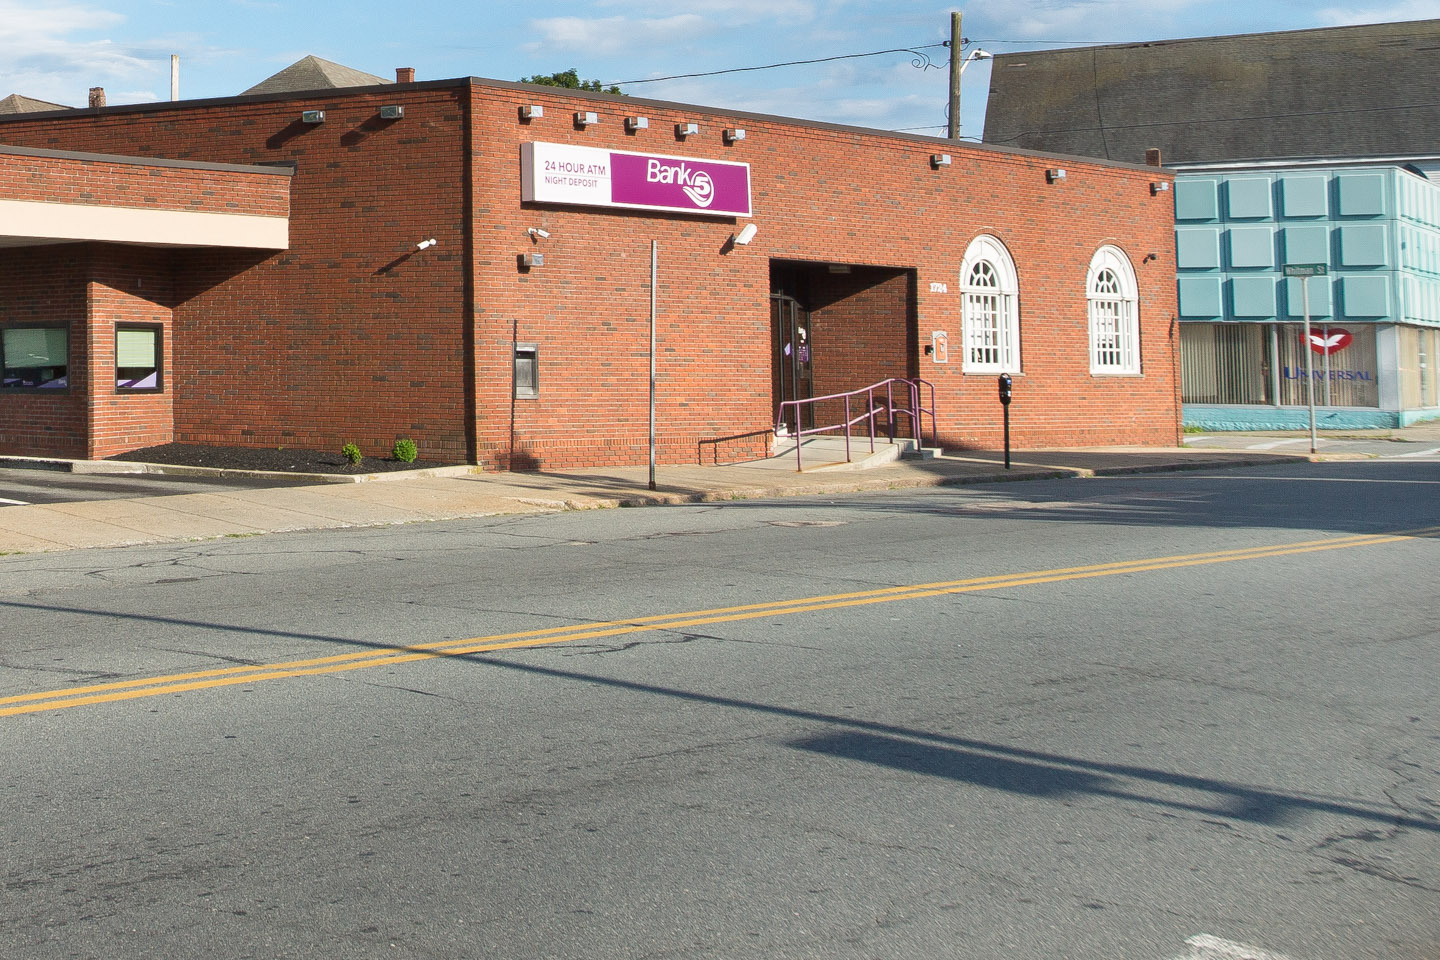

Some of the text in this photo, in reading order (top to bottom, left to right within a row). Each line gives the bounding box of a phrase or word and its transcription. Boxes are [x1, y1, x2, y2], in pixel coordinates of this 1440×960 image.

[545, 161, 606, 176] 24 HOUR ATM
[545, 176, 598, 188] NIGHT DEPOSIT
